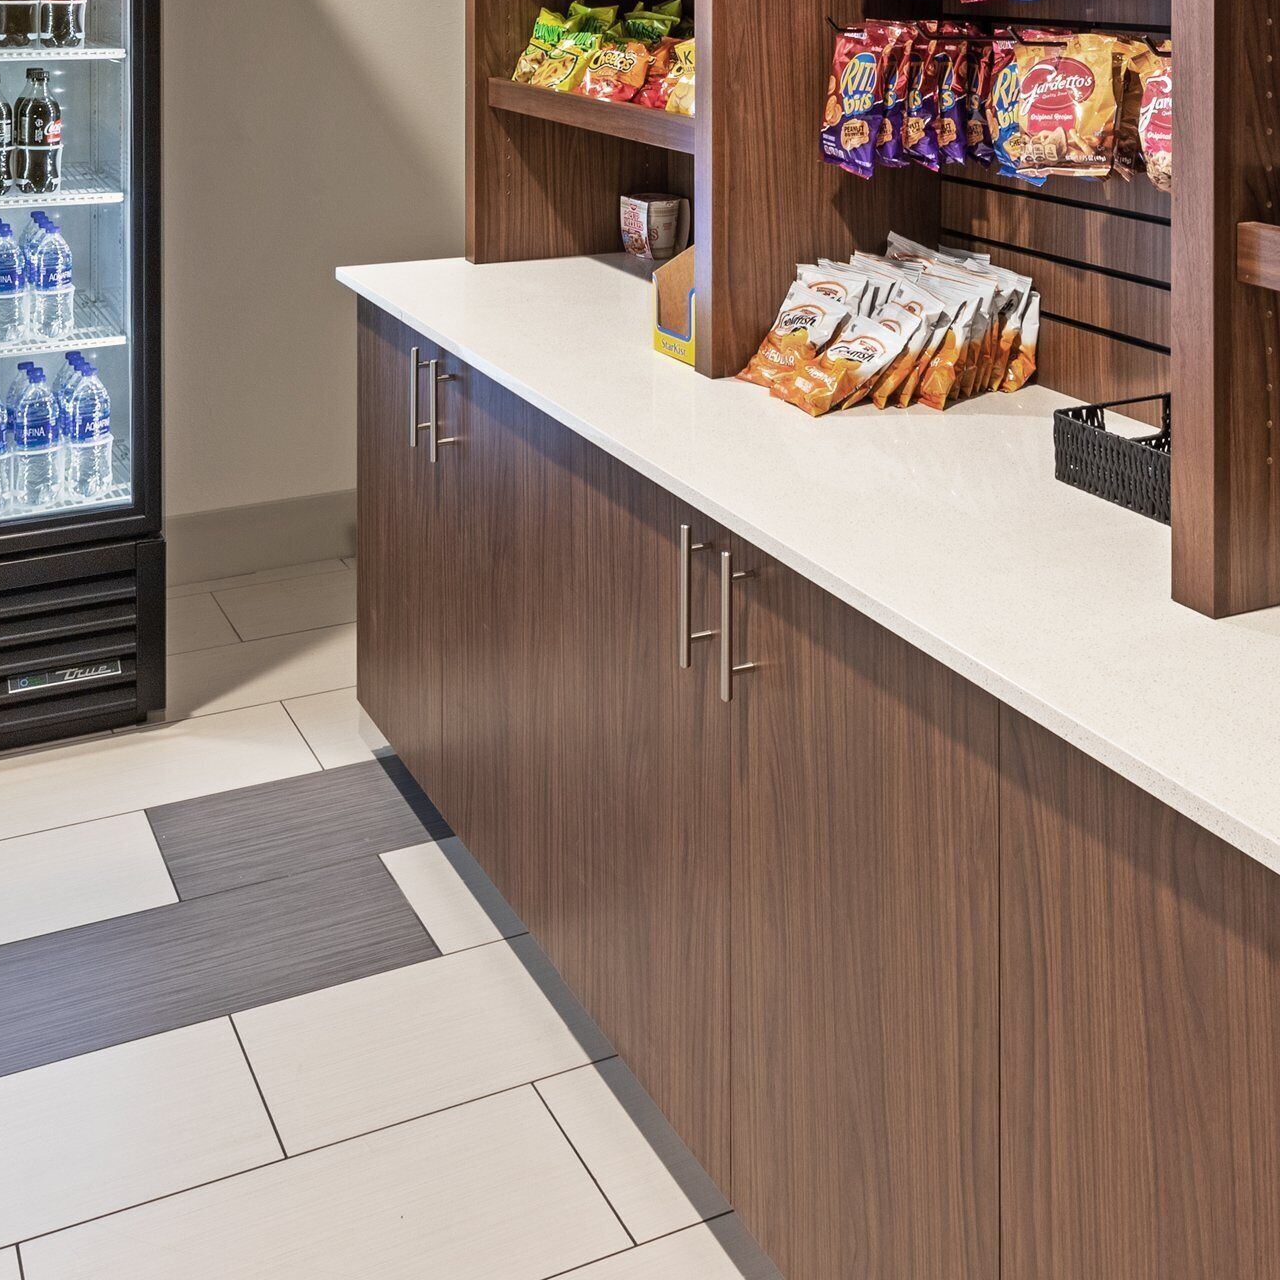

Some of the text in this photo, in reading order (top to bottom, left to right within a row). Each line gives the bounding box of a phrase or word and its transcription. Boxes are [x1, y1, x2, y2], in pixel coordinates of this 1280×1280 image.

[842, 59, 877, 95] RITZ
[1020, 64, 1092, 115] Gardetto's
[842, 94, 873, 114] bits
[662, 338, 686, 356] StarKist
